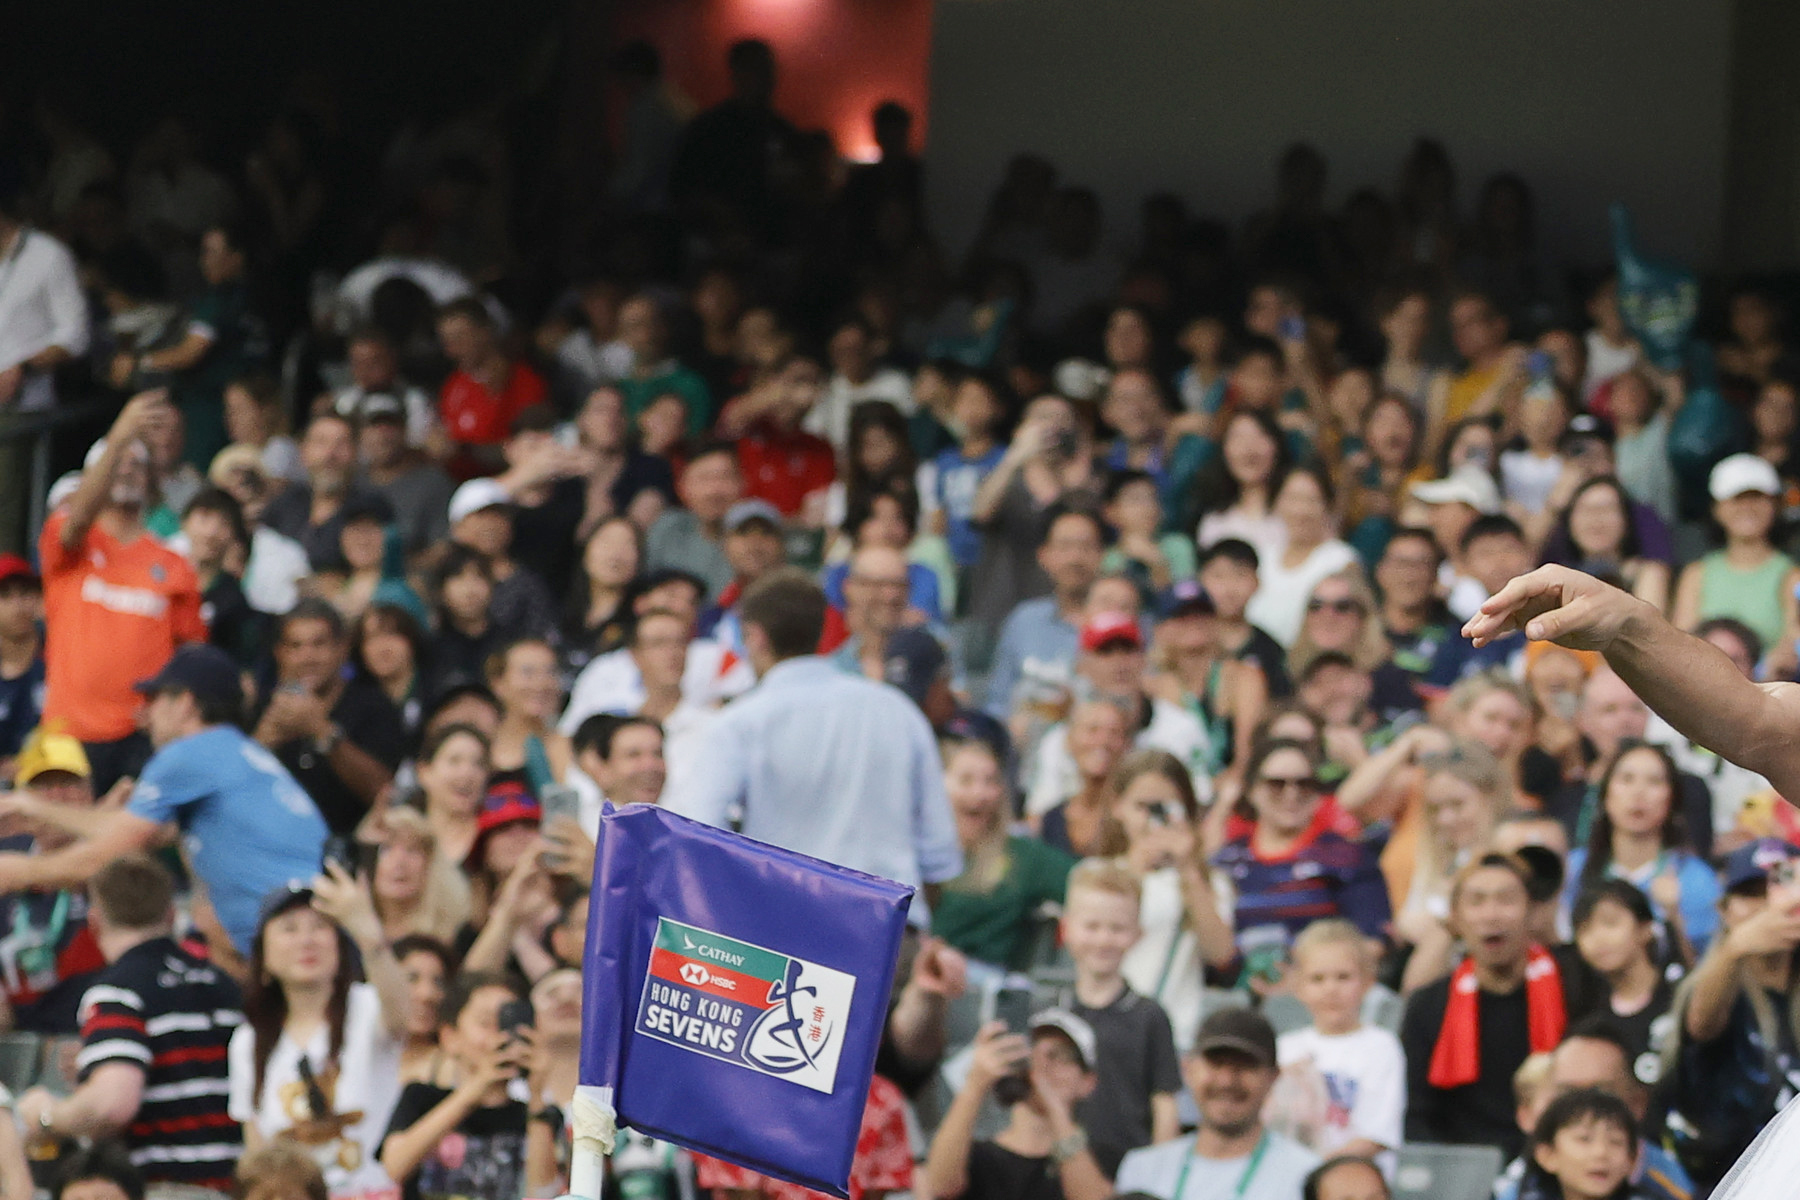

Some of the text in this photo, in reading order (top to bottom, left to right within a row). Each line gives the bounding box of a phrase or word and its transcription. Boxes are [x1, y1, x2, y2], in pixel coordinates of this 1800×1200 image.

[698, 944, 745, 967] CATHAY
[710, 974, 737, 990] HSBC
[650, 982, 744, 1027] HONG KONG
[645, 1004, 738, 1053] SEVENS
